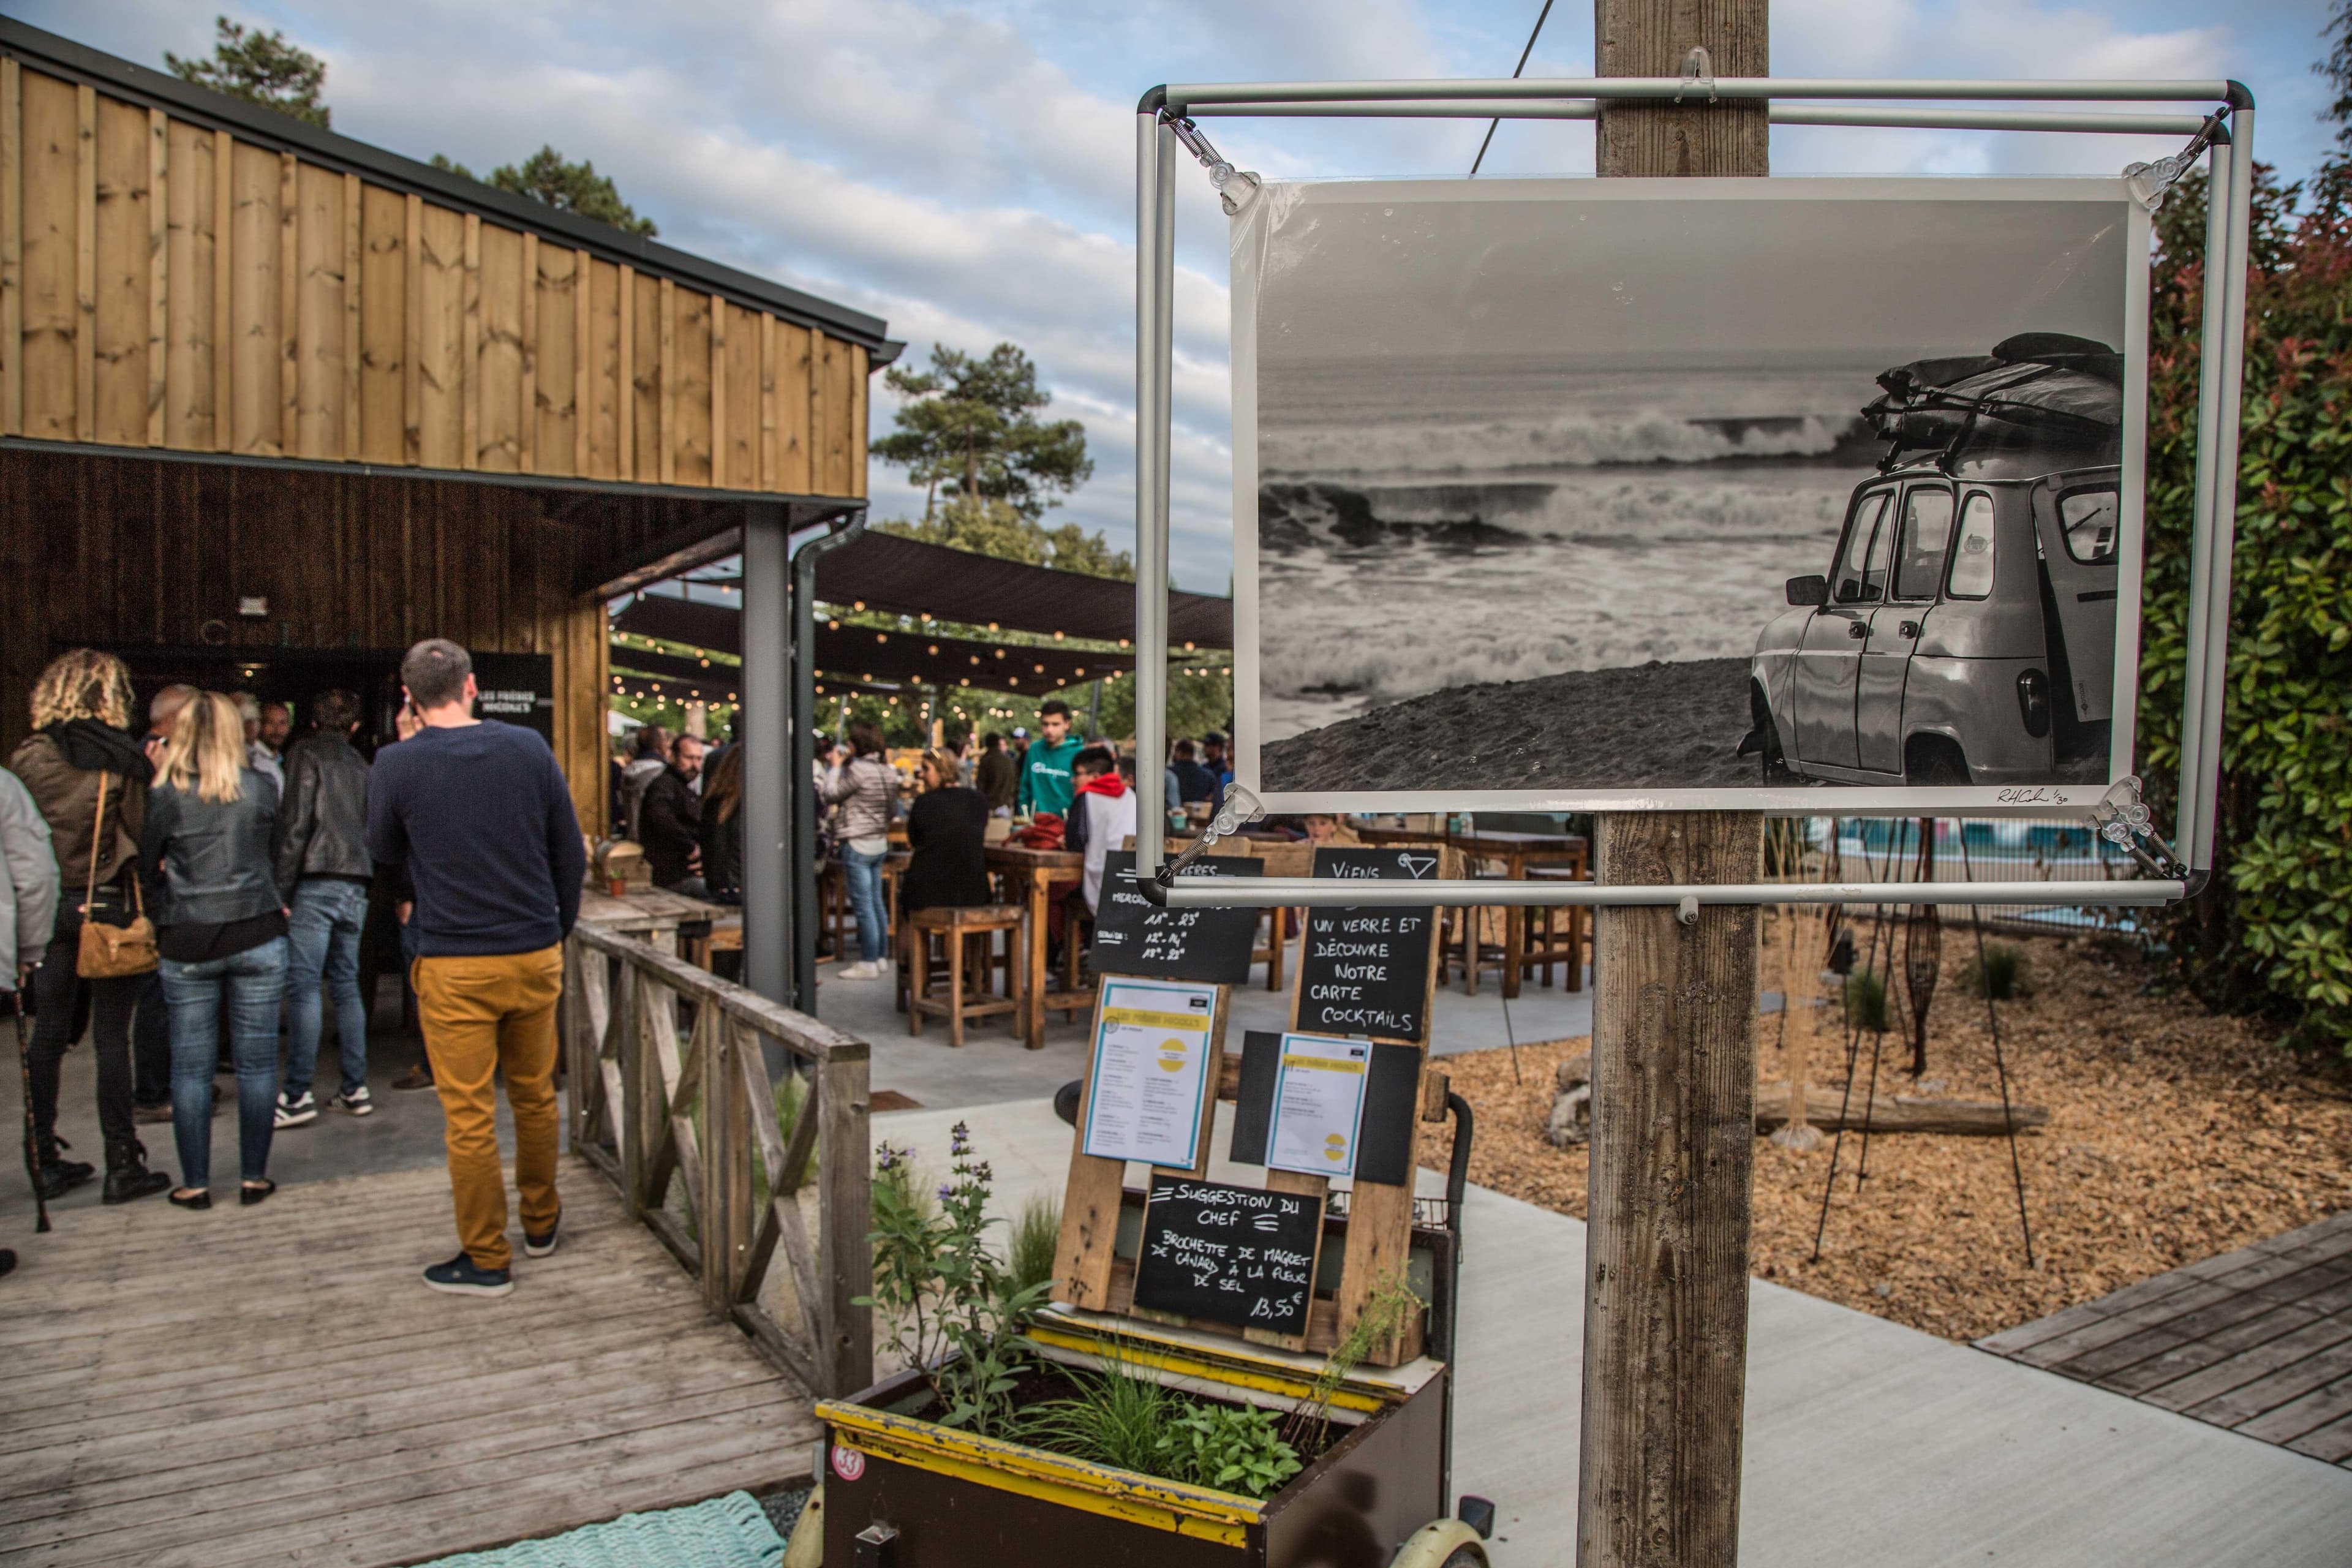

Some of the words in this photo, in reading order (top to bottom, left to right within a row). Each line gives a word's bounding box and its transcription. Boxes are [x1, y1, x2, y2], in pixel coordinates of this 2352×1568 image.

[1314, 920, 1334, 932] UN
[1343, 918, 1392, 933] VERRE
[1399, 918, 1422, 933] ET
[1335, 963, 1387, 981] NOTRE
[1310, 985, 1362, 1001] CARTE
[1280, 1199, 1299, 1215] DU
[1162, 1229, 1229, 1257] BROCHETTE
[1238, 1246, 1255, 1260] DE
[1264, 1248, 1312, 1267] MAGRET
[1151, 1244, 1167, 1257] DE
[1175, 1253, 1219, 1276] CANARD
[1247, 1265, 1264, 1278] LA
[1272, 1265, 1308, 1284] FLEUR
[1193, 1274, 1210, 1287] DE
[1219, 1279, 1245, 1293] SEL
[839, 1448, 858, 1473] 33
